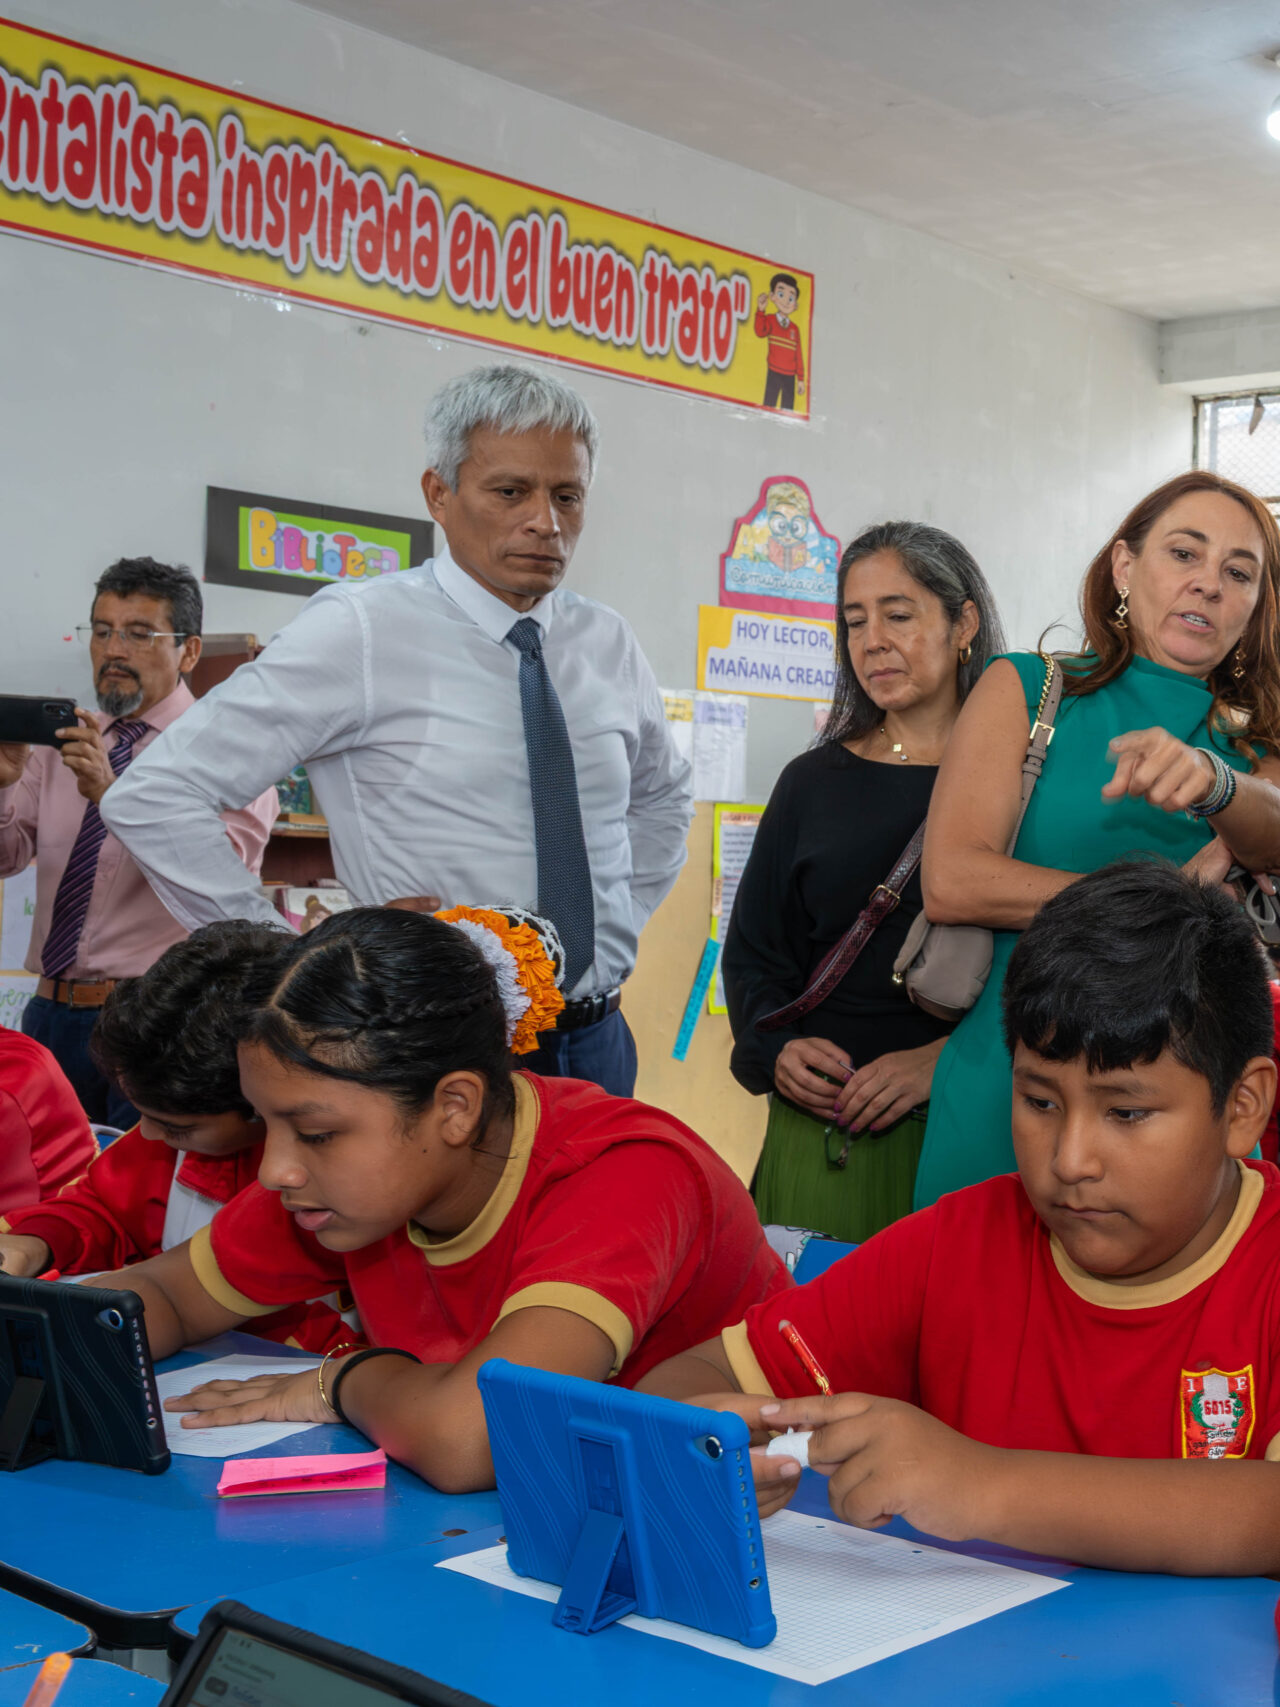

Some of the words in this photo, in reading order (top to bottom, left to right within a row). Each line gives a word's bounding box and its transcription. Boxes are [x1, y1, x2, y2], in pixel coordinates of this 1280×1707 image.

[0, 76, 210, 230] ntalista
[220, 121, 440, 290] inspirada
[449, 210, 496, 303] en
[506, 219, 541, 316] el
[550, 220, 636, 340] buen
[737, 621, 769, 641] HOY
[774, 625, 833, 651] LECTOR,
[709, 656, 782, 682] MAÑANA
[1234, 1376, 1248, 1391] E
[1203, 1400, 1233, 1416] 6015
